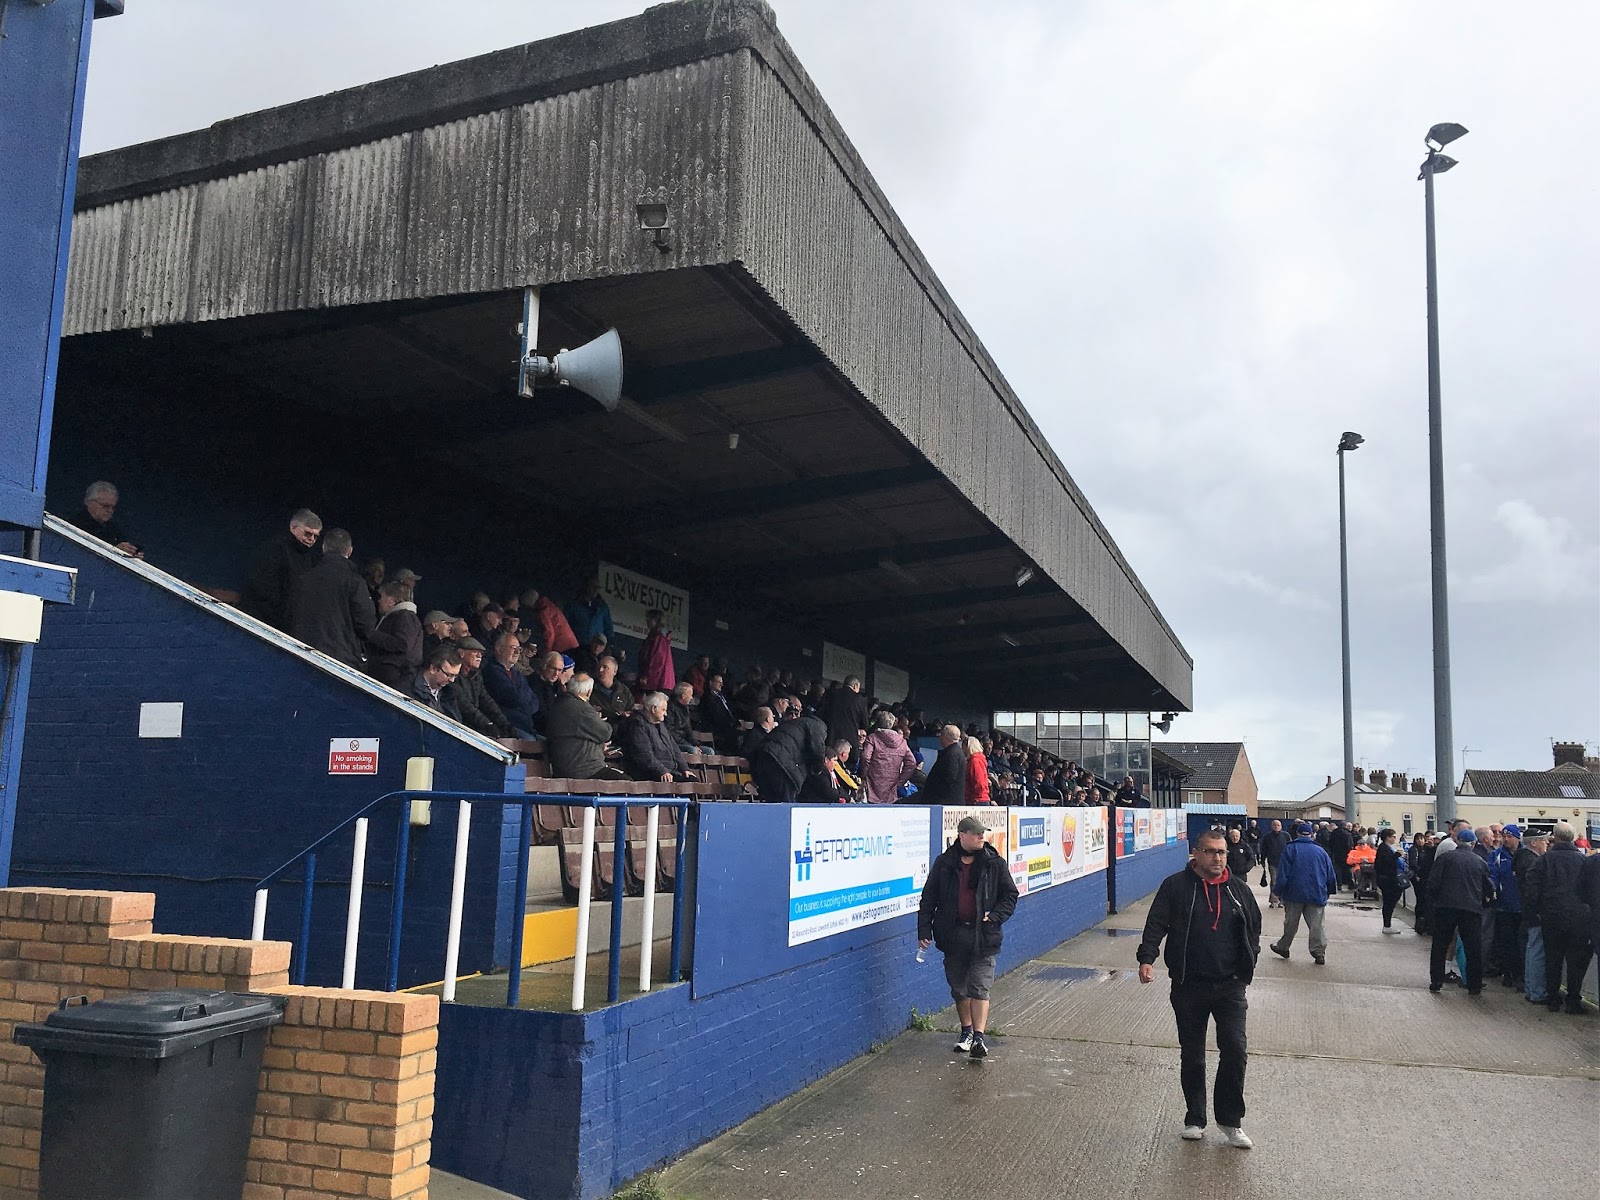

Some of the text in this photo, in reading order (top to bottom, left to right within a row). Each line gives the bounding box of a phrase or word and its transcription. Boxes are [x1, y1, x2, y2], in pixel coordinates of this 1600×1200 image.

[346, 755, 372, 763] smoking
[814, 835, 893, 863] PETROGRAMME
[794, 902, 802, 914] Our
[803, 900, 820, 912] business
